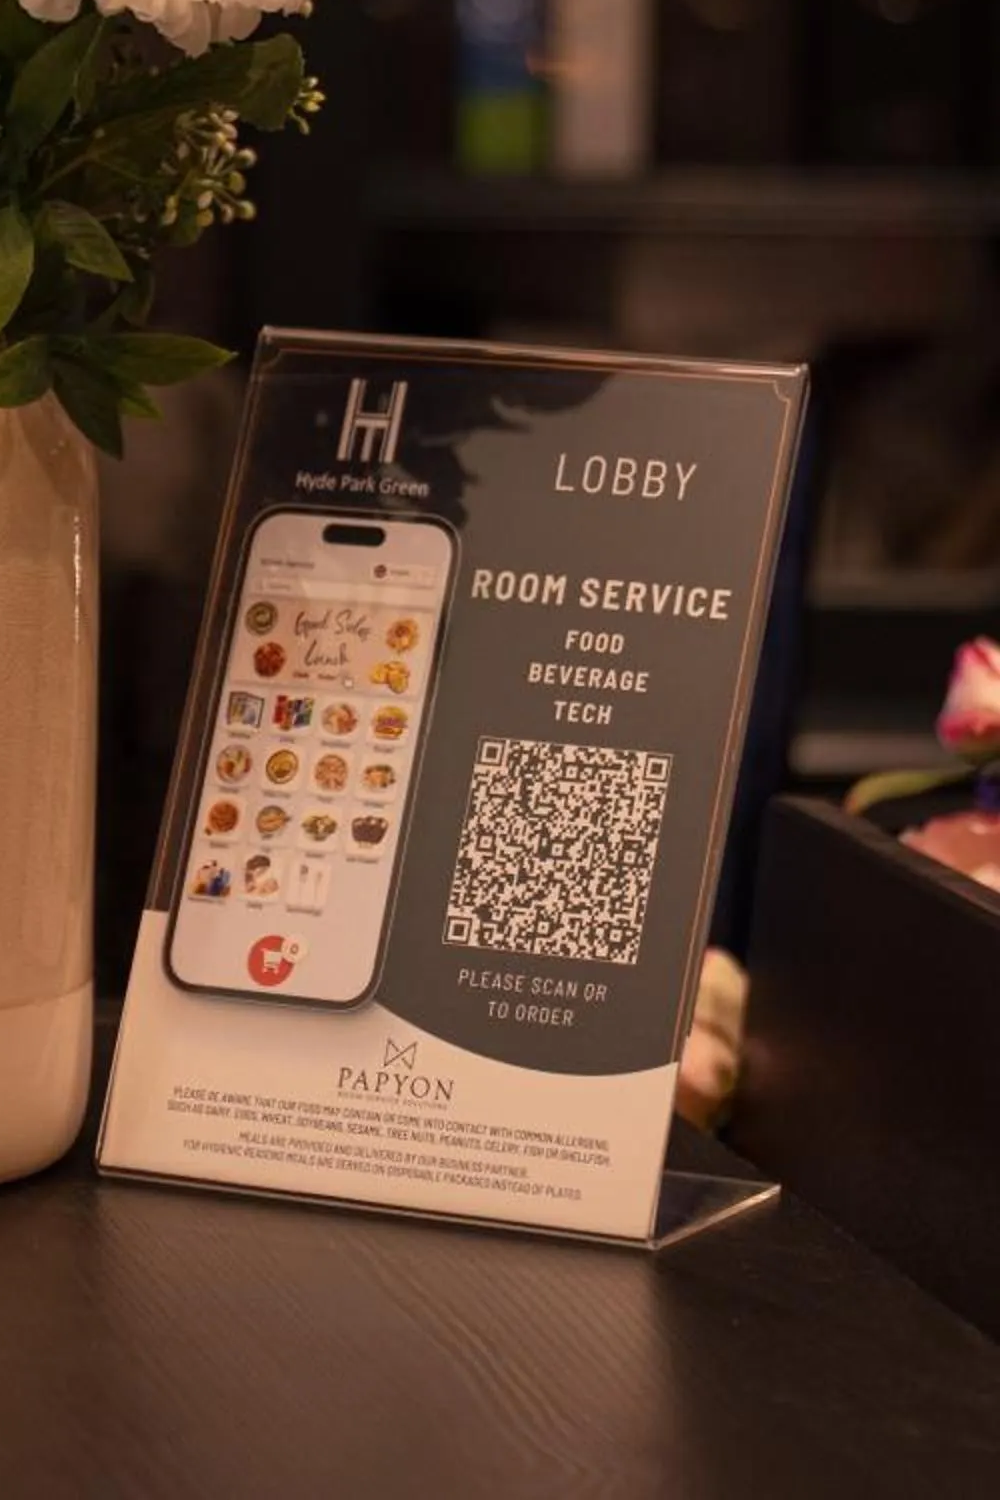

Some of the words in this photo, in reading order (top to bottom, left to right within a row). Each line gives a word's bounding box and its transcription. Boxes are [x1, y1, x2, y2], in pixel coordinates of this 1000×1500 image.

[295, 470, 336, 491] Hyde
[340, 474, 375, 492] Park
[379, 476, 429, 497] Green
[554, 452, 698, 501] LOBBY
[471, 569, 567, 606] ROOM
[579, 577, 732, 620] SERVICE
[565, 629, 625, 654] FOOD
[527, 662, 649, 692] BEVERAGE
[553, 700, 613, 725] TECH
[457, 968, 526, 993] PLEASE
[531, 976, 578, 999] SCAN
[487, 1001, 510, 1020] TO
[515, 1002, 575, 1028] ORDER
[338, 1066, 455, 1101] PAPYON
